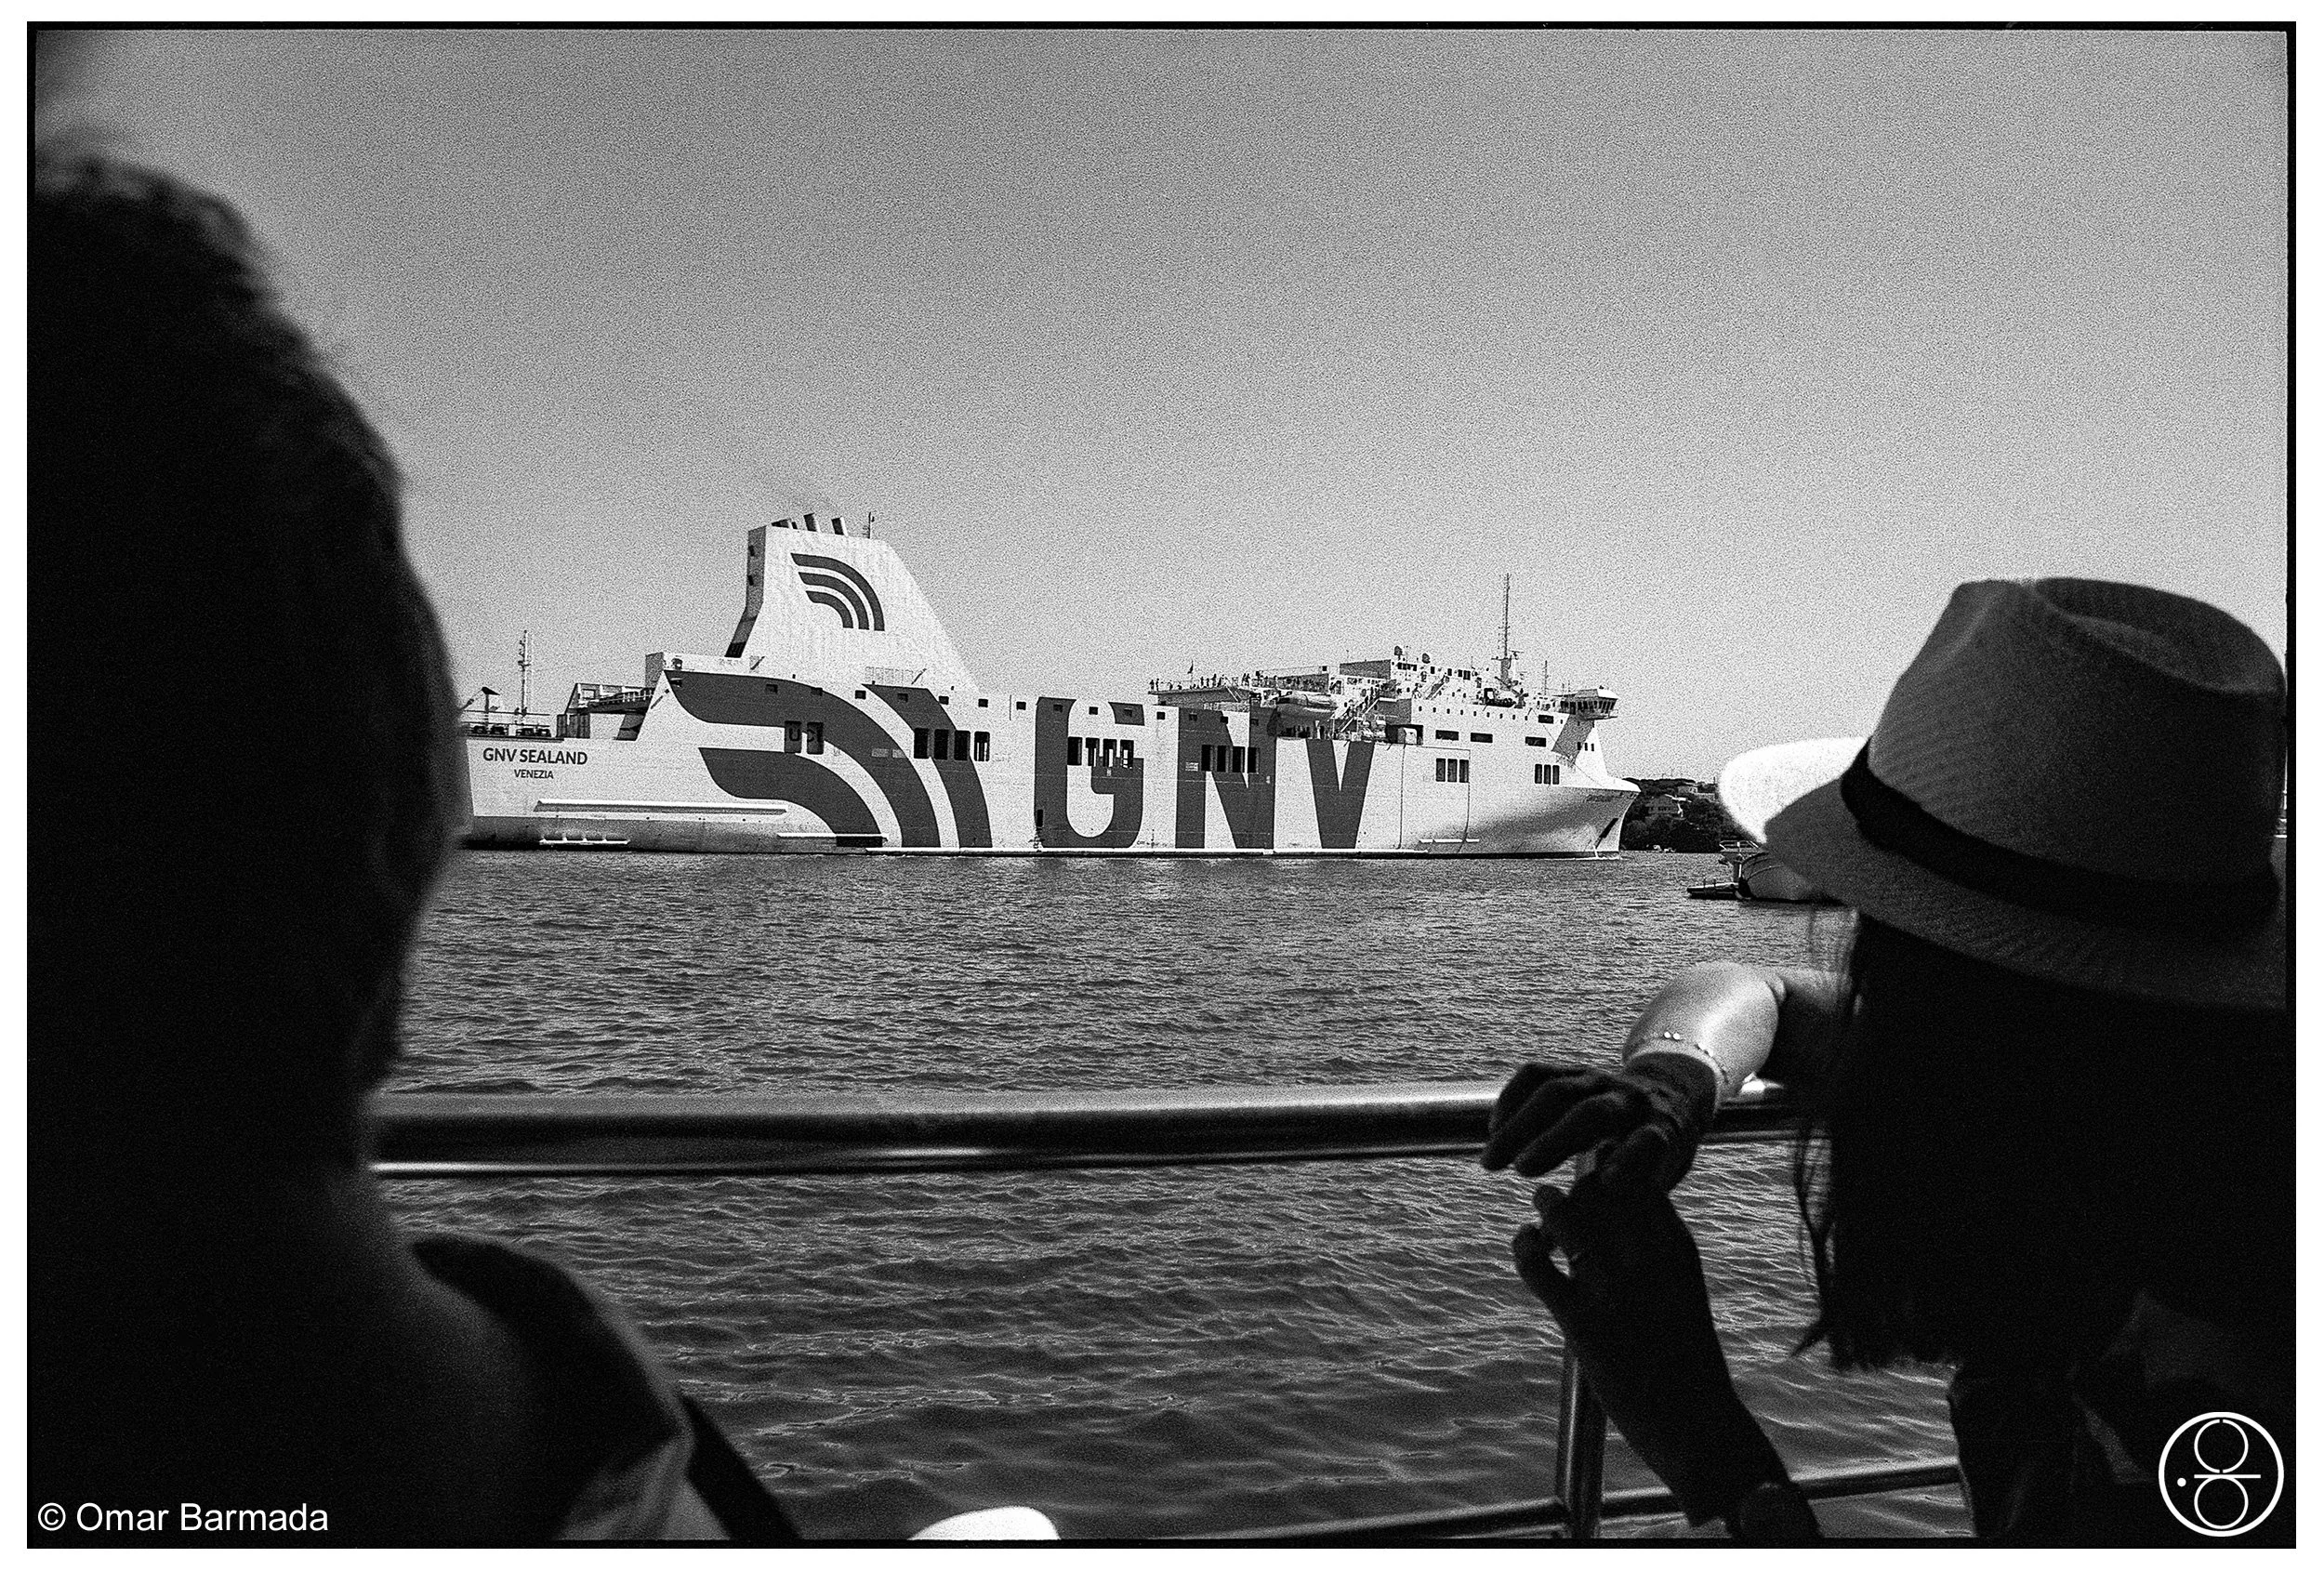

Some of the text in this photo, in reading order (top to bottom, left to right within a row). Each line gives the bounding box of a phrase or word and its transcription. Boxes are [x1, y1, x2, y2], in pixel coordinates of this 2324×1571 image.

[483, 747, 588, 765] GNV SEALAND
[514, 769, 554, 779] VENEZIA
[1034, 697, 1375, 849] GNV
